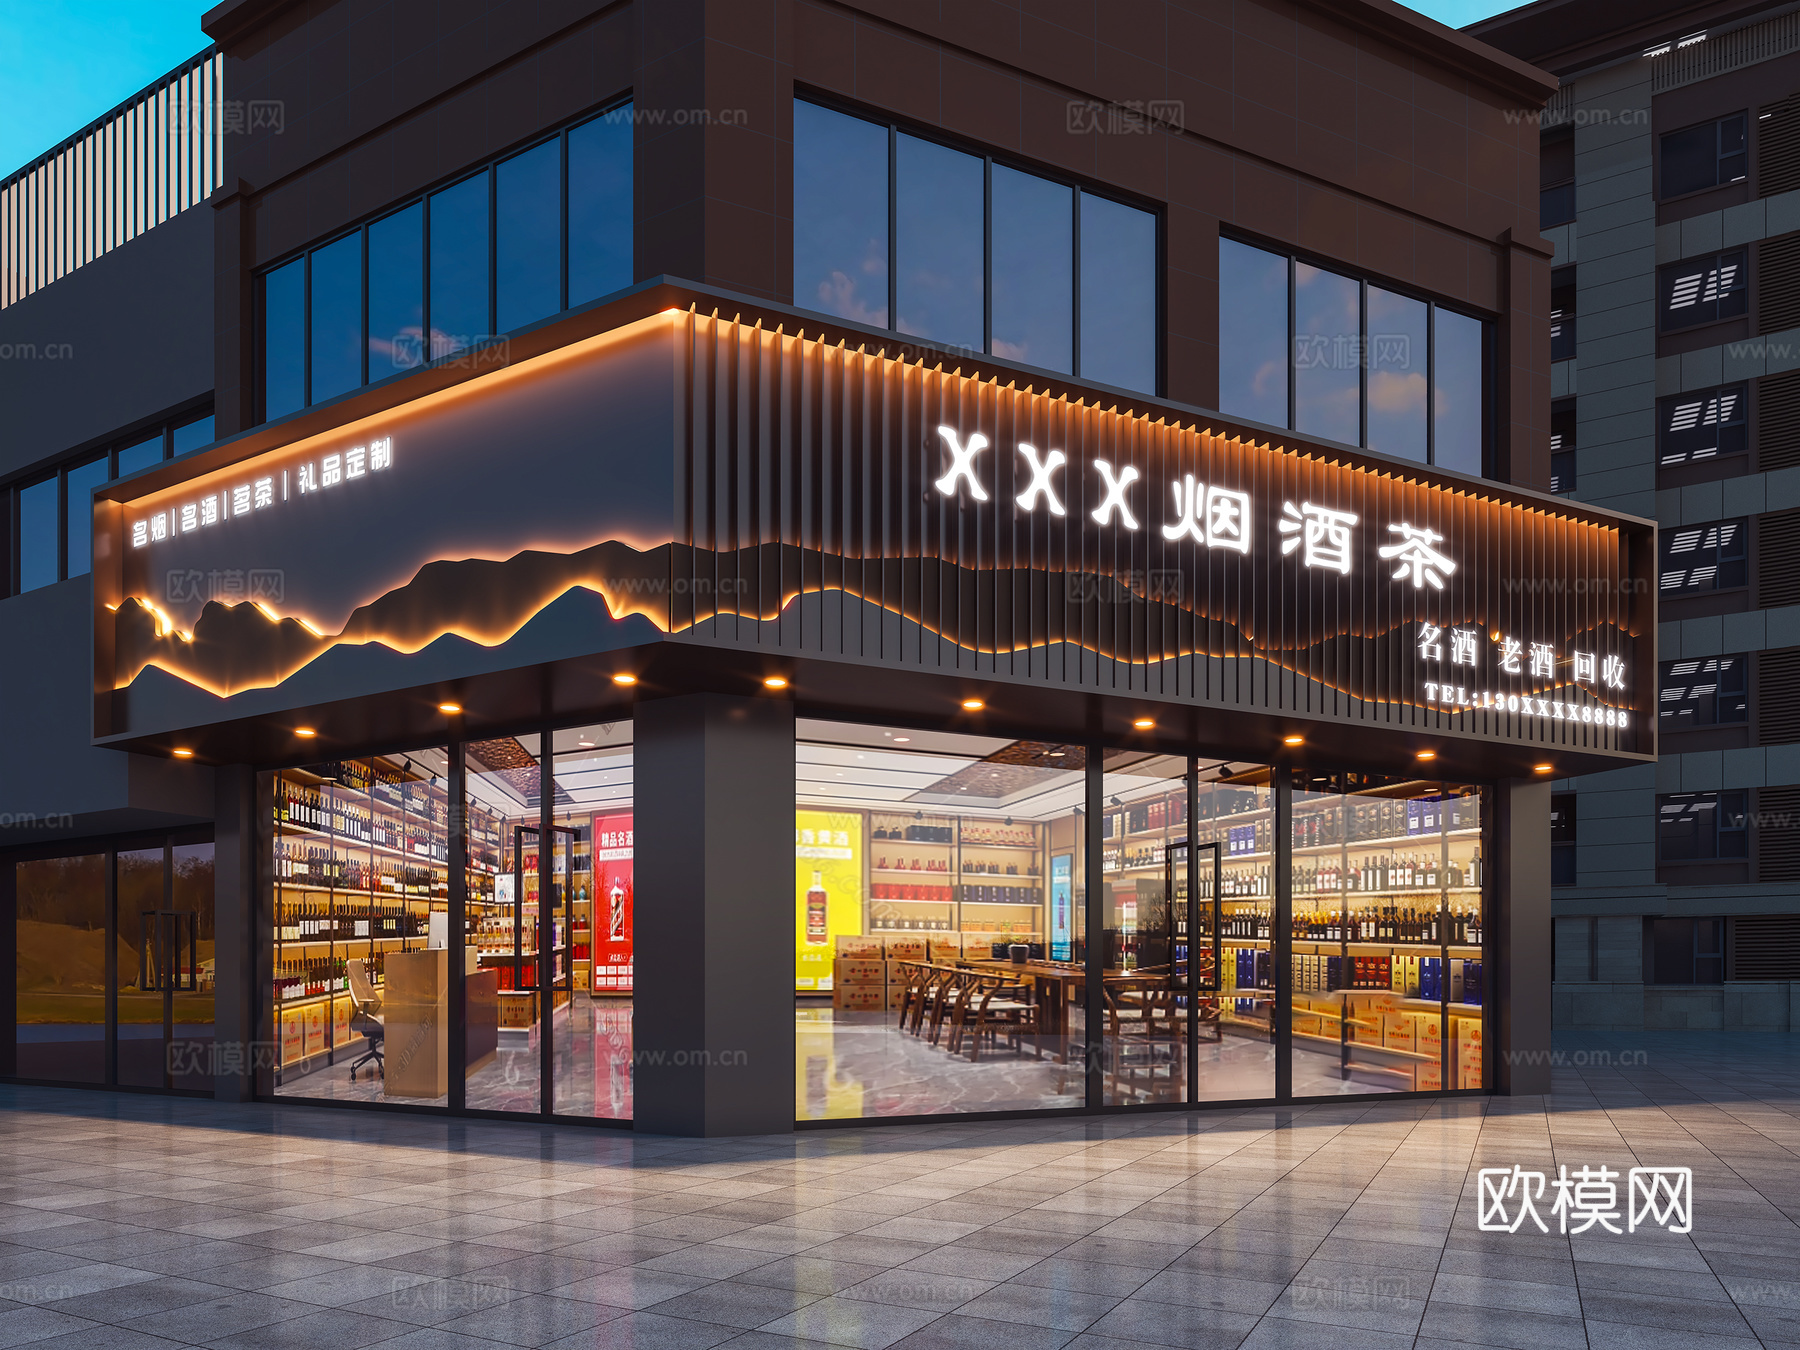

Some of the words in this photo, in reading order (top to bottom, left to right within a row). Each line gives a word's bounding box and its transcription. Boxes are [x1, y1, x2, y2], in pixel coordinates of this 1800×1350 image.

[298, 436, 392, 494] 礼品定制
[1417, 621, 1477, 667] 名酒
[1497, 635, 1554, 679] 老酒
[1574, 650, 1626, 690] 回收
